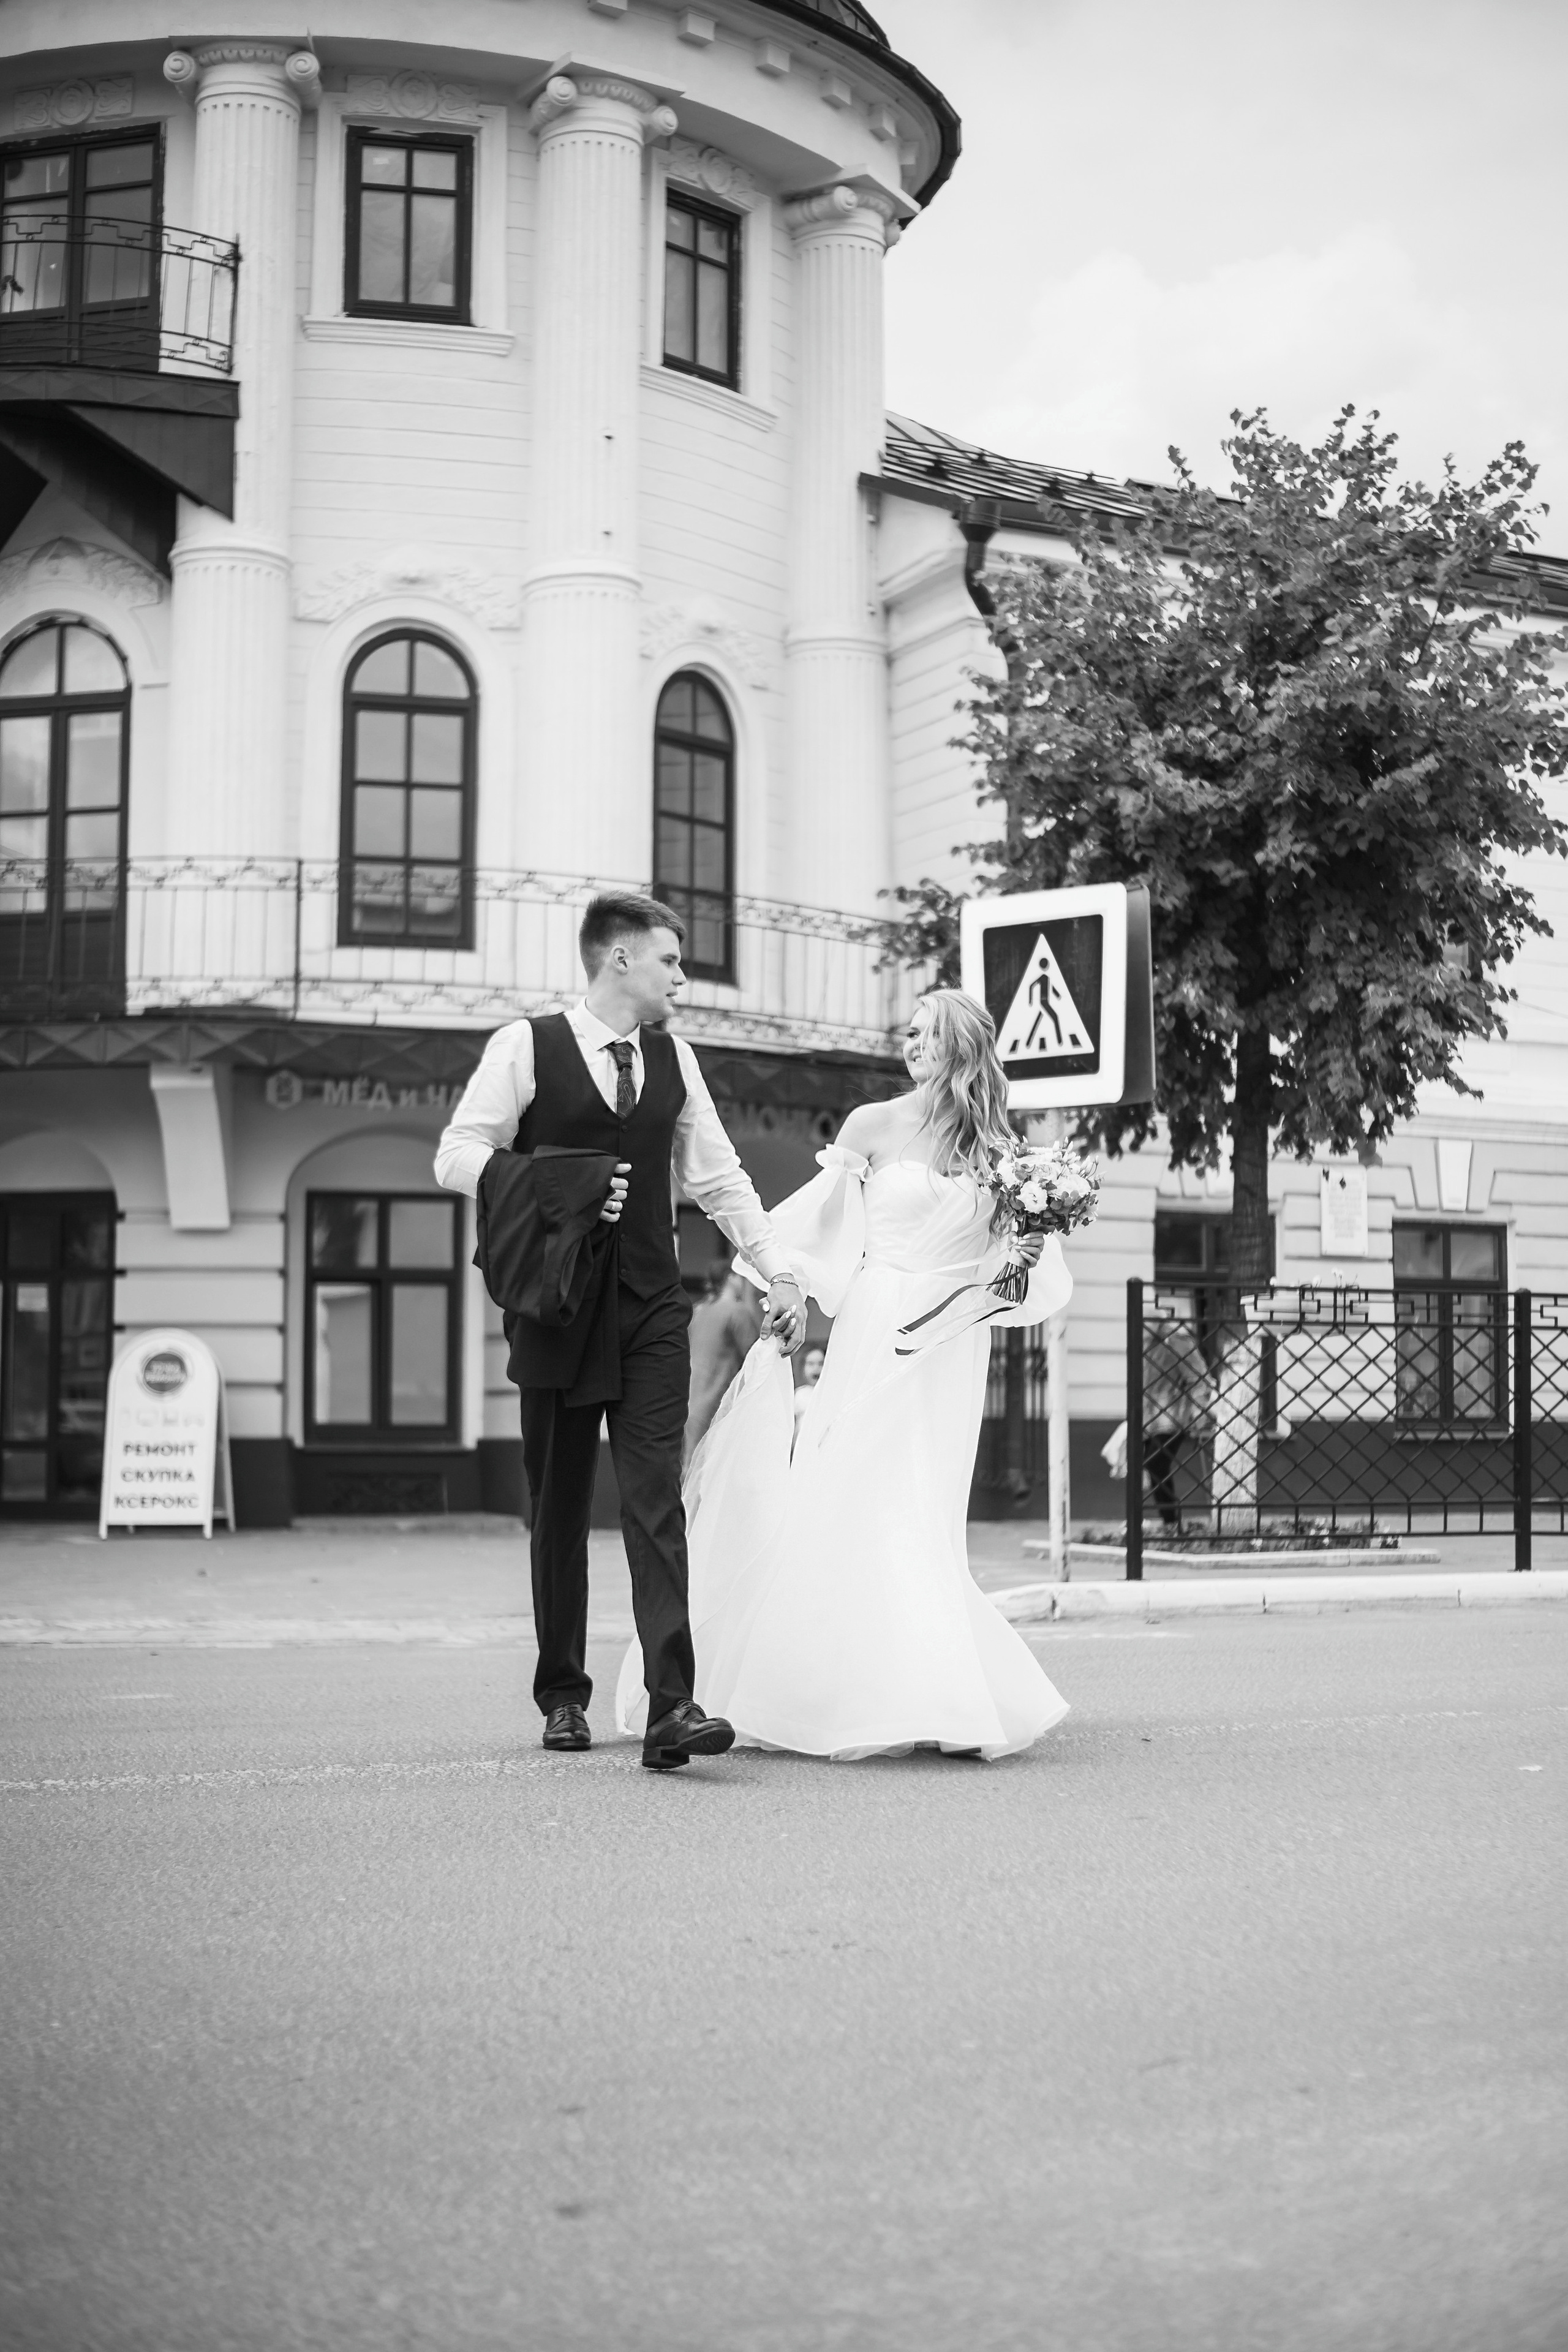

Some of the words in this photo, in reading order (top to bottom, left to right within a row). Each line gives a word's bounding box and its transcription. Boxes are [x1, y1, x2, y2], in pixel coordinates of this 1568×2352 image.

[323, 1076, 392, 1110] МЁД
[428, 1084, 466, 1108] ЧА
[123, 1441, 197, 1457] РЕМОНТ
[121, 1467, 195, 1483] СКУПКА
[114, 1493, 200, 1509] КСЕРОКС
